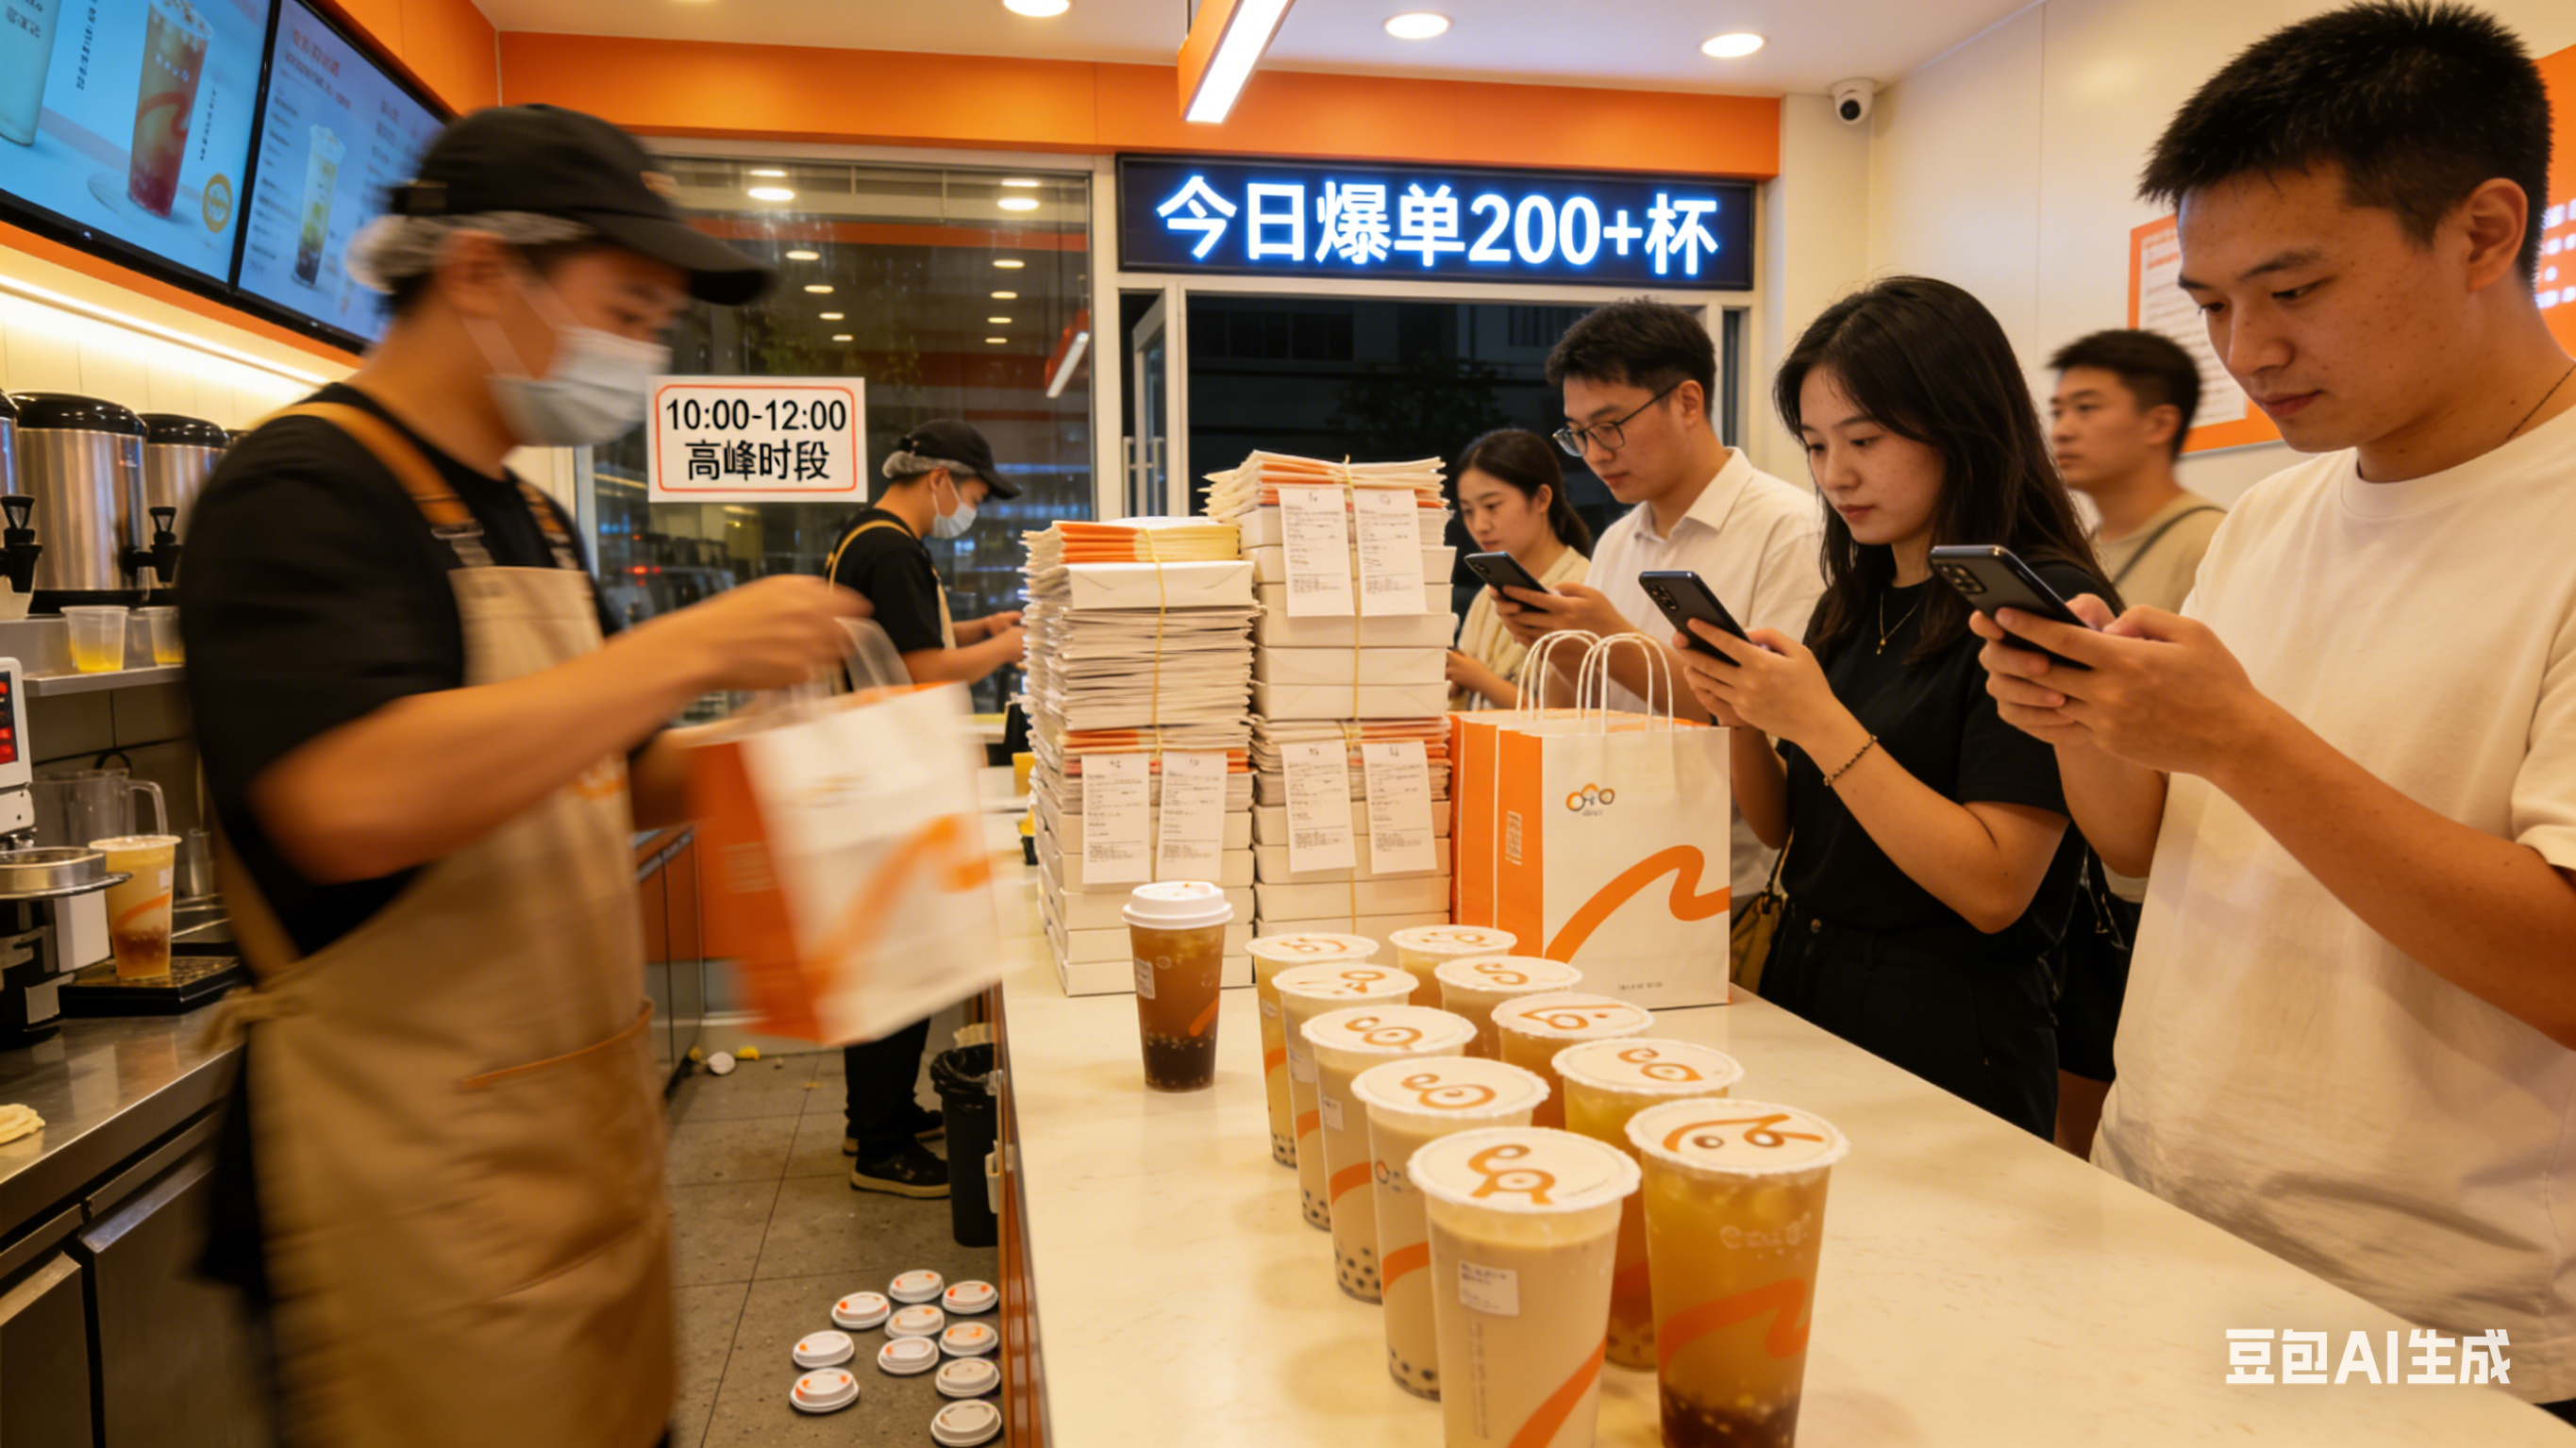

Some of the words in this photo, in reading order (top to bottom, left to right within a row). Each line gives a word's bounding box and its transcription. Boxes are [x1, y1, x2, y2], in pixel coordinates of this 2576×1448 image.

[1157, 175, 1719, 275] 今日爆单200+杯
[666, 397, 846, 431] 10:00-12:00
[685, 439, 830, 482] 高峰时段
